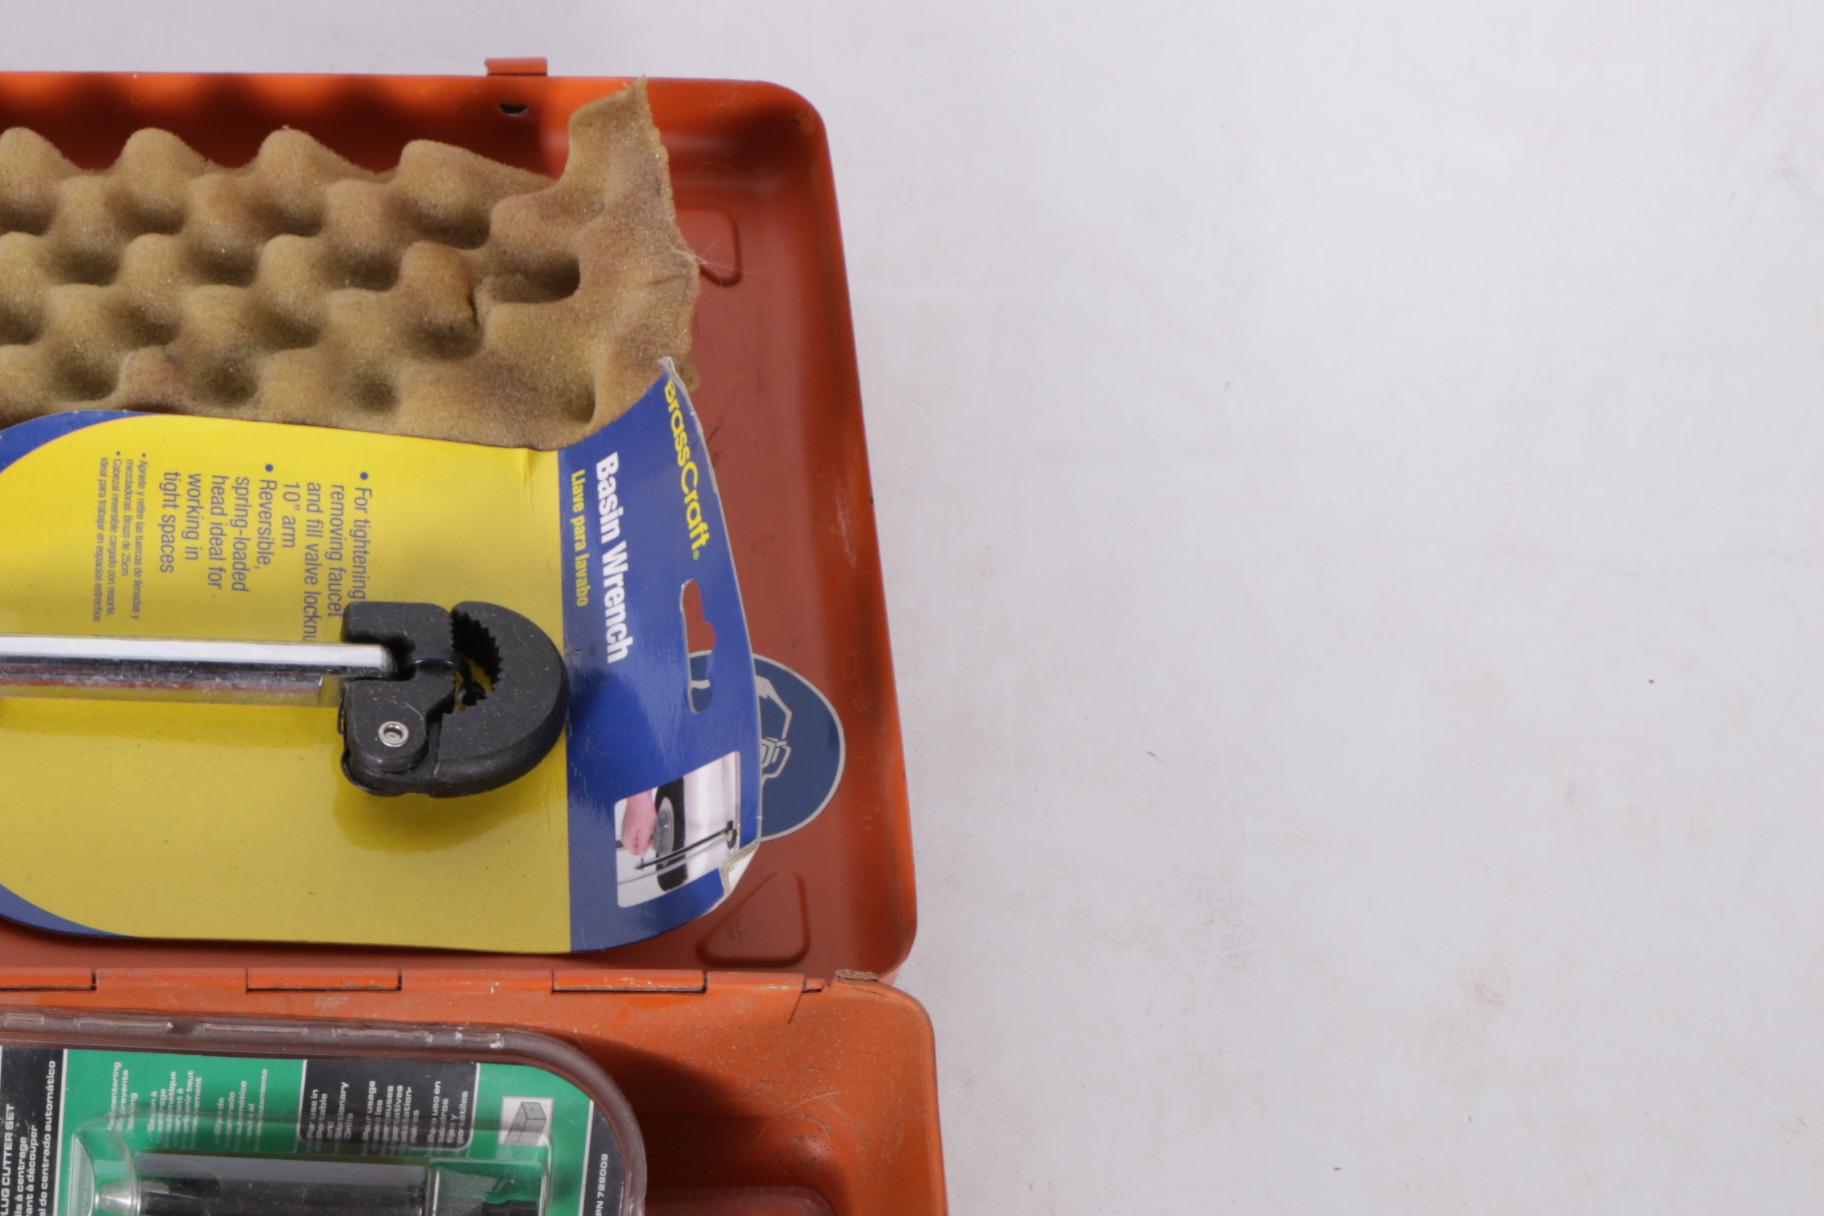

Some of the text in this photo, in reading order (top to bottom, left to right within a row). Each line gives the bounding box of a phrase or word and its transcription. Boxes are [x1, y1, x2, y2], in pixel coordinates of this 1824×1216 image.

[158, 471, 182, 574] tight spaces
[181, 473, 204, 561] working in
[255, 478, 278, 569] Reversible,
[306, 482, 324, 513] and
[207, 474, 229, 590] head ideal for
[230, 476, 254, 593] spring-loaded
[281, 515, 297, 549] arm
[305, 518, 325, 538] fill
[326, 484, 347, 618] removing faucet
[348, 487, 373, 599] For tightening
[570, 469, 591, 607] Llave para lavabo
[305, 543, 323, 587] valve
[595, 452, 634, 664] Basin Wrench
[5, 1103, 15, 1130] SET
[45, 1060, 56, 1131] automático
[1, 1132, 14, 1186] CUTTER
[17, 1136, 28, 1192] centrage
[26, 1125, 39, 1182] découper
[41, 1133, 51, 1190] centrado
[597, 1153, 609, 1200] 728009
[38, 1191, 48, 1203] de
[595, 1200, 604, 1216] PN
